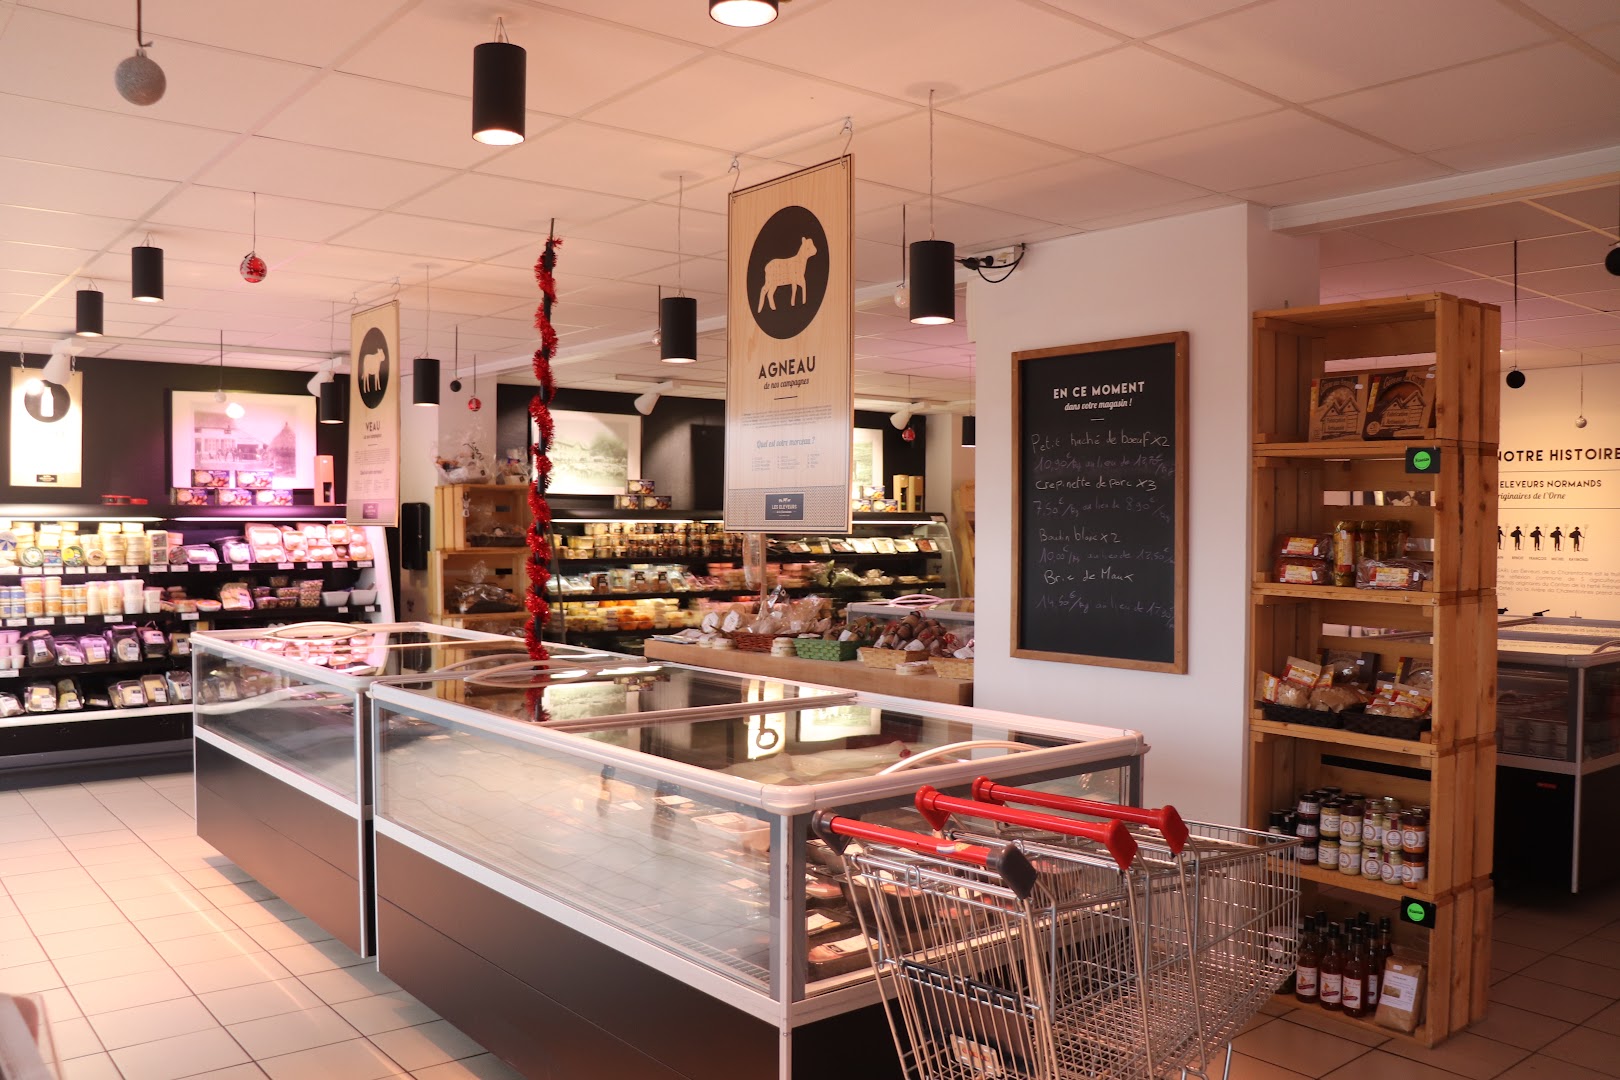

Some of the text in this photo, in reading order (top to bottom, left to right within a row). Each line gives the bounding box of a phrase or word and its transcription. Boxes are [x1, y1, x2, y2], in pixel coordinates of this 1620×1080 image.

[758, 355, 816, 379] AGNEAU
[764, 382, 770, 390] de
[780, 378, 810, 388] campagnes
[1053, 381, 1145, 399] EN CE MOMENT
[1064, 398, 1132, 411] dans votre magasin !
[365, 421, 380, 432] VEAU
[756, 440, 768, 449] Quel
[789, 438, 811, 446] morceau
[1032, 434, 1060, 454] Petit
[1106, 430, 1118, 445] de
[1550, 448, 1620, 461] HISTOIRE
[1096, 476, 1108, 488] de
[1108, 478, 1132, 491] porc
[1500, 480, 1602, 488] ELEVEURS NORMANDS
[1533, 492, 1540, 500] de
[1040, 528, 1070, 542] Boudin
[1073, 526, 1098, 541] blanc
[1082, 570, 1096, 582] de
